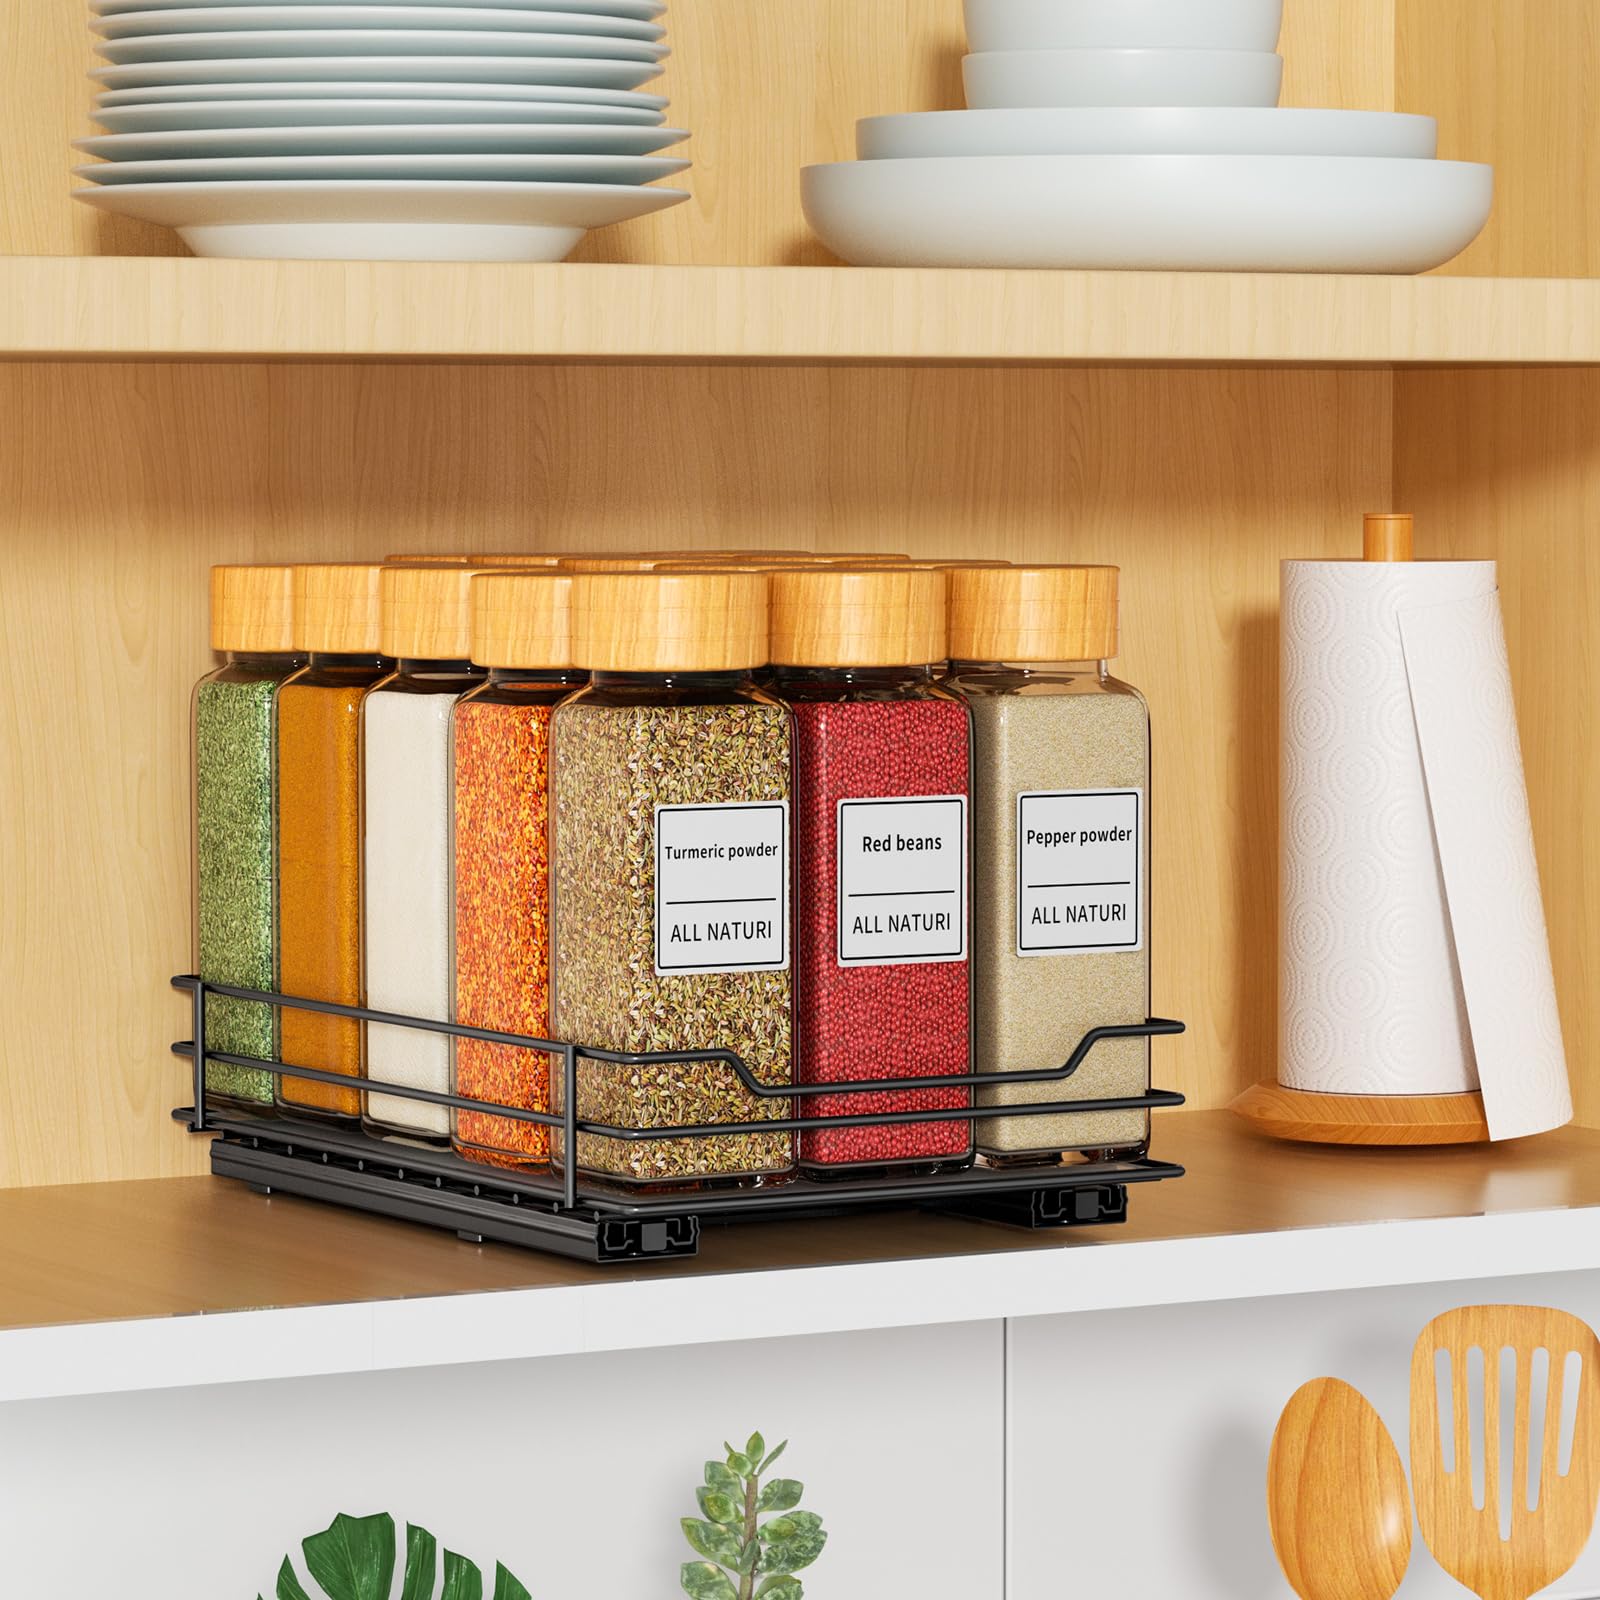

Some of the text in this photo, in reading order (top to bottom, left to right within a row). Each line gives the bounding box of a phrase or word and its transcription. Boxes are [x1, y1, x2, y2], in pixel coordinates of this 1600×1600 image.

[862, 833, 942, 853] Red beans
[1027, 825, 1133, 848] Pepper powder
[664, 841, 778, 861] Turmeric powder
[852, 912, 951, 935] ALL NATURI
[1031, 903, 1126, 925] ALL NATURI
[670, 920, 772, 943] ALL NATURI
